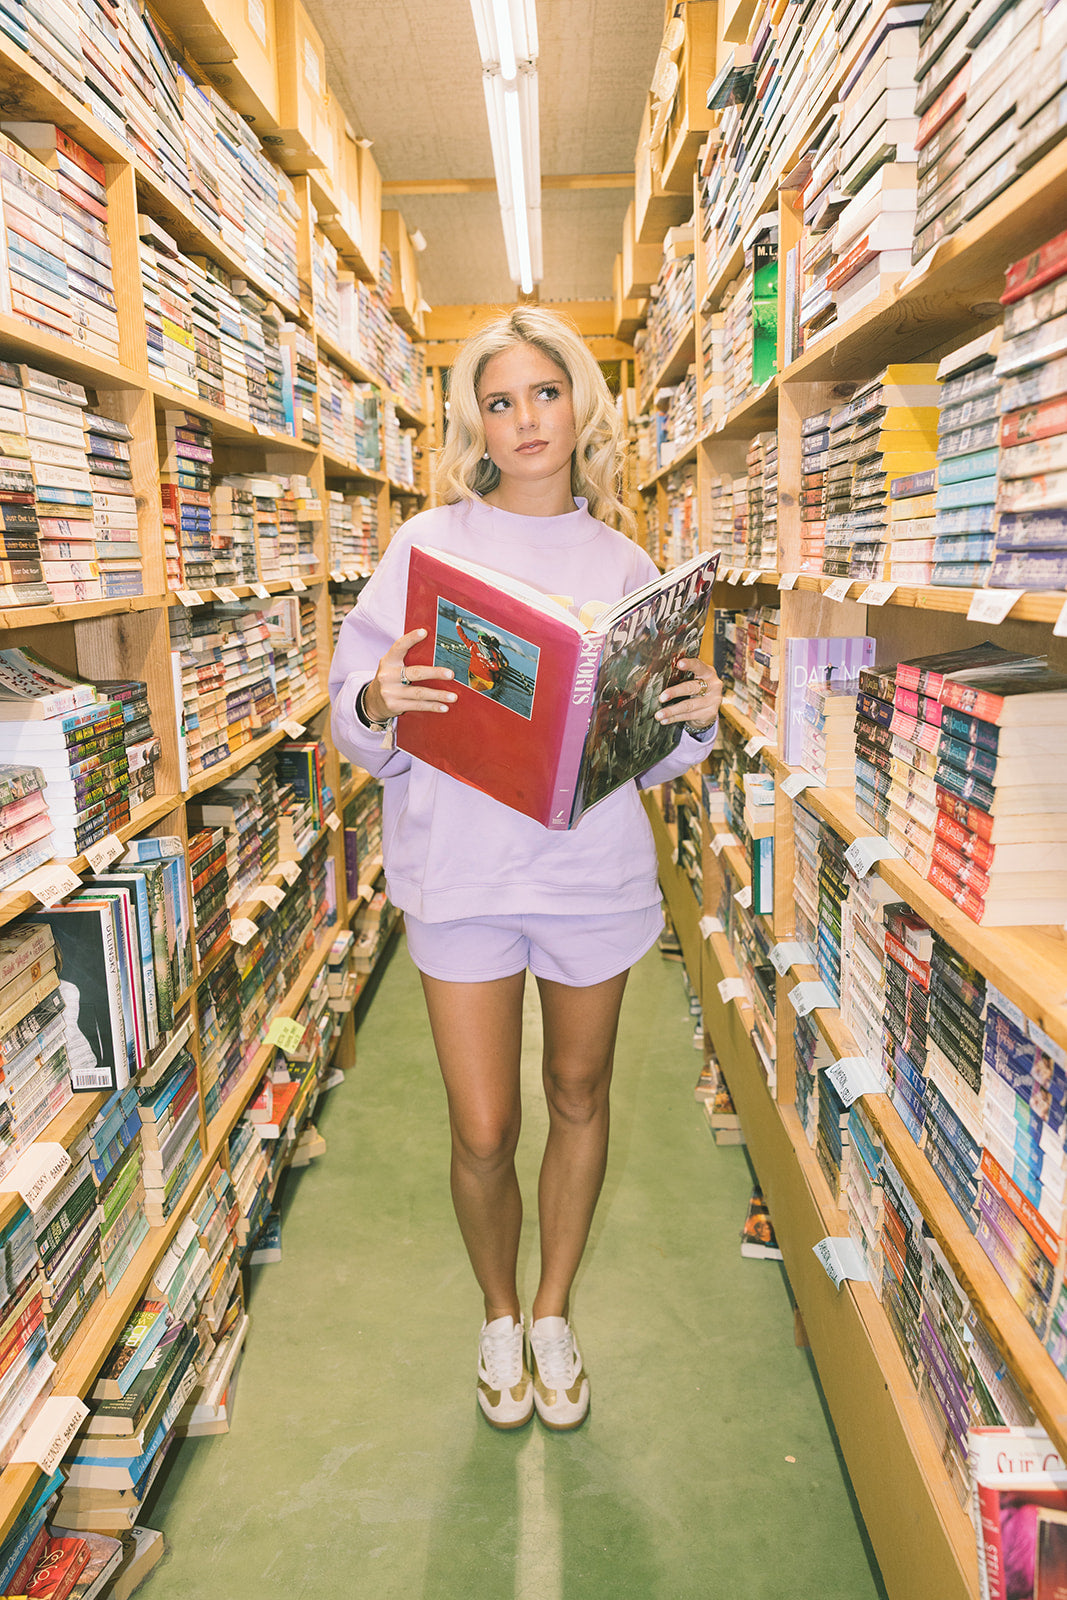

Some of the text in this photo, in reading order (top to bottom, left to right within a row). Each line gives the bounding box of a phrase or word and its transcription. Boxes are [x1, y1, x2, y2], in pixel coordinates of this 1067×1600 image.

[611, 558, 717, 656] SPORTS
[572, 637, 603, 706] SPORTS
[106, 924, 116, 975] DELINSKY
[139, 891, 150, 954] DELINSKY
